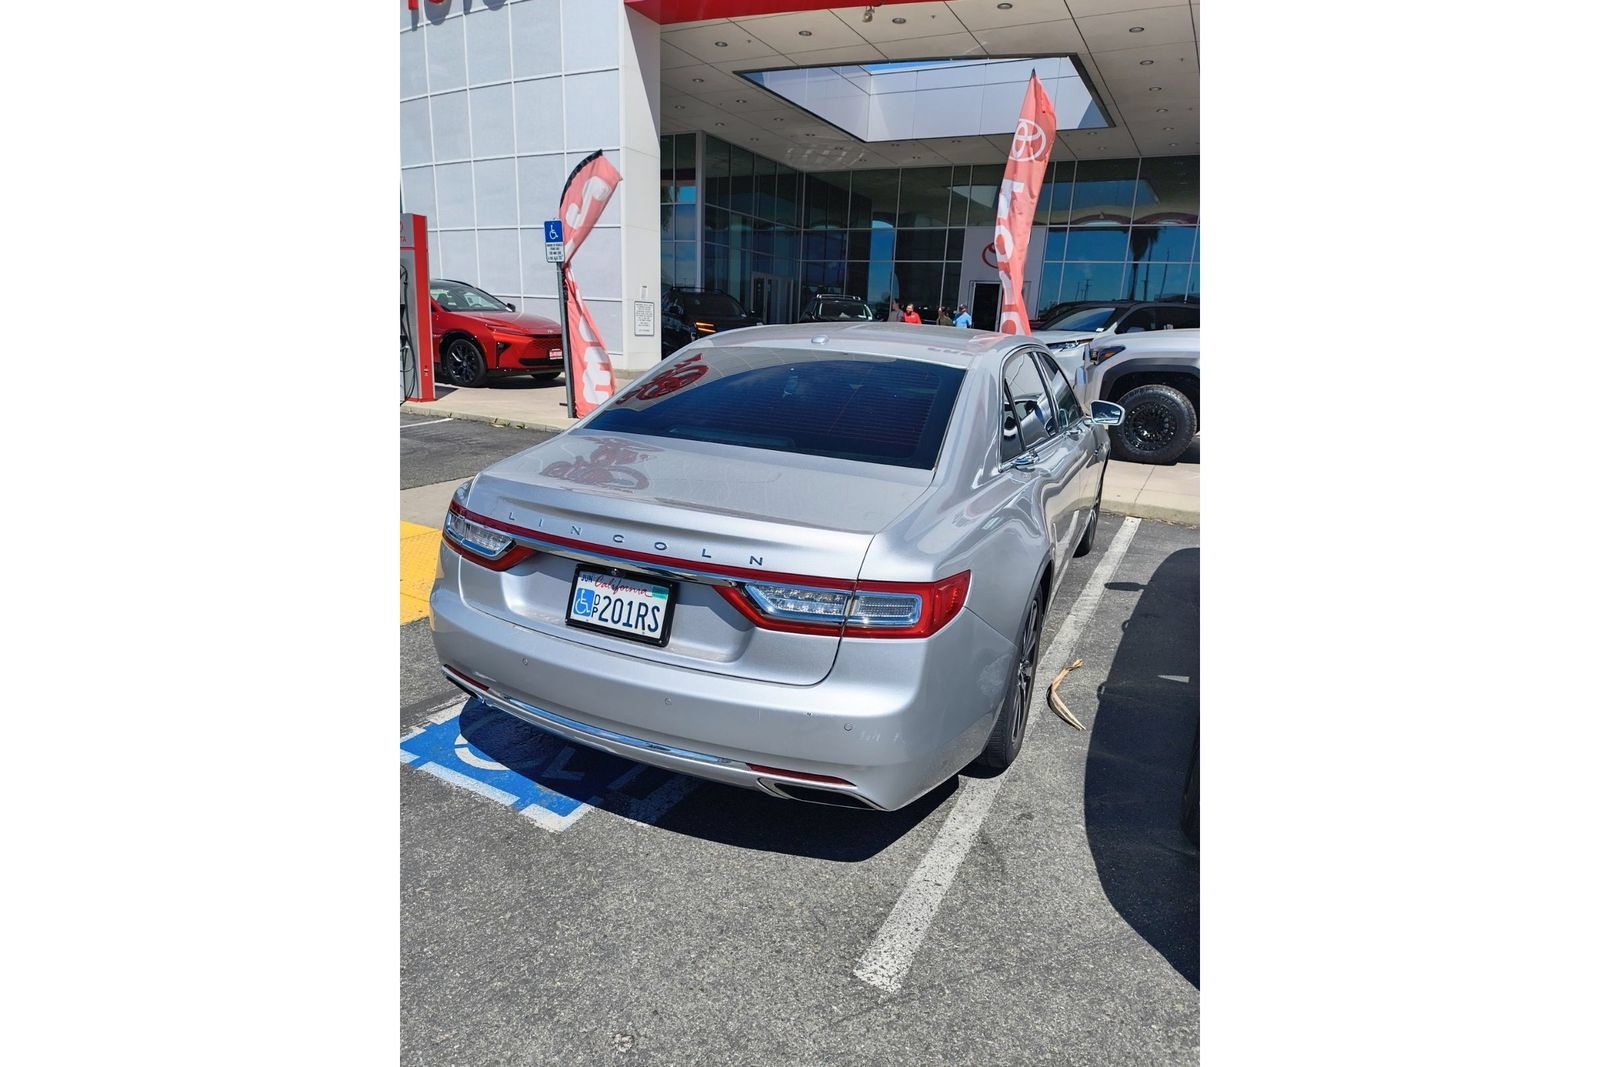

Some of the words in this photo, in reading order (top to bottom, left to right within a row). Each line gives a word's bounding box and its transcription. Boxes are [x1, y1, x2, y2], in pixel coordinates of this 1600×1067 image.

[508, 511, 763, 567] LINCOLN
[594, 575, 653, 598] California
[598, 595, 661, 633] 201RS
